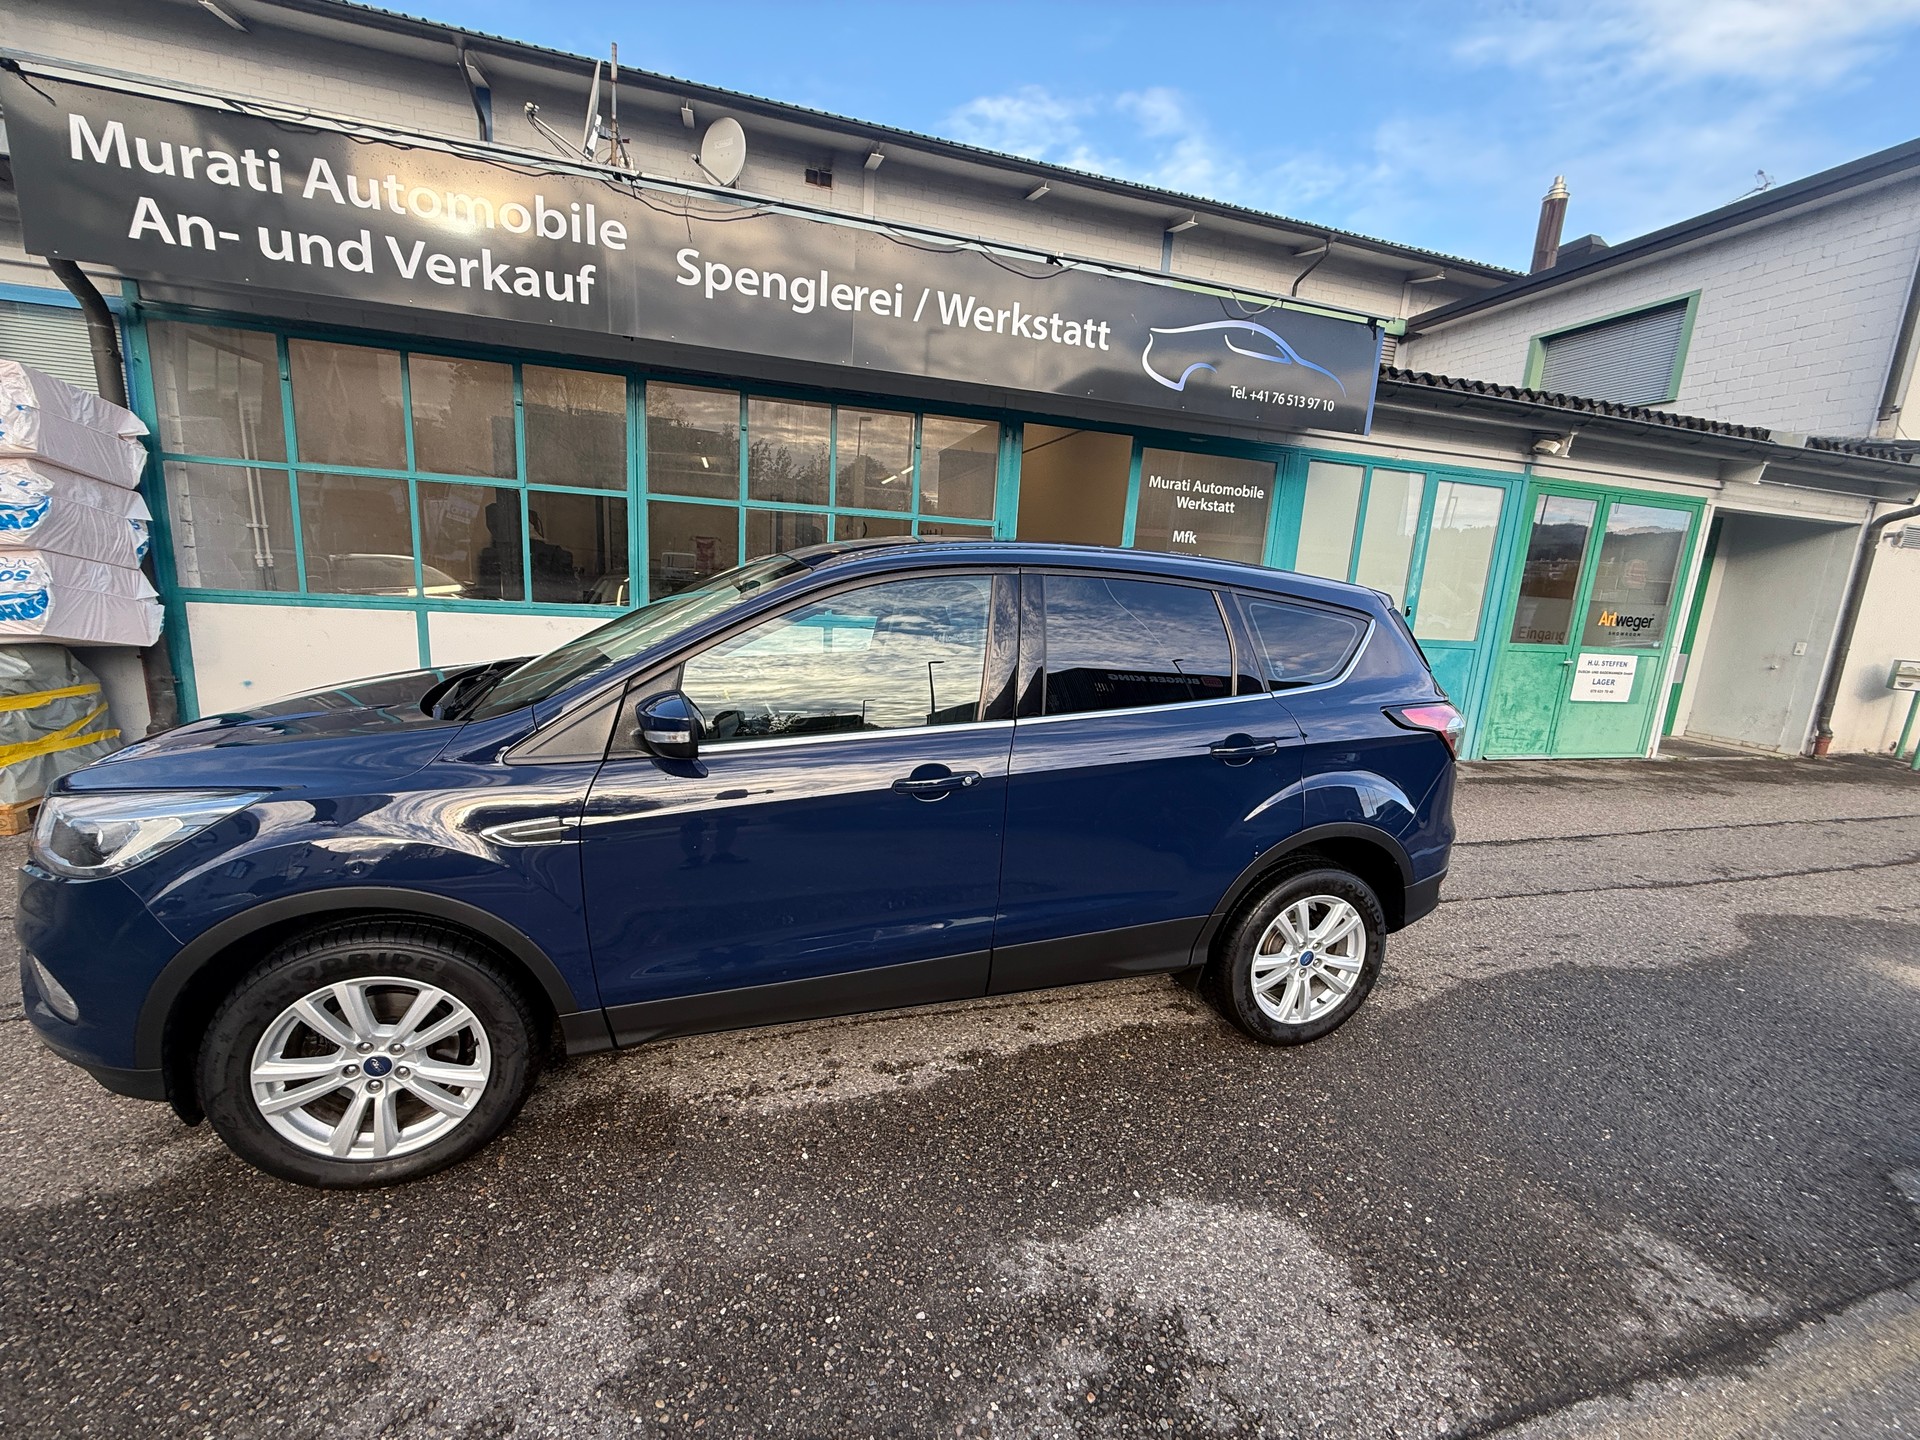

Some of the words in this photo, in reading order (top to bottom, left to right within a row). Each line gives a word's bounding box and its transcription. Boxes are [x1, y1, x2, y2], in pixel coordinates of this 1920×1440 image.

[68, 113, 282, 194] Murati
[303, 157, 628, 251] Automobile
[128, 197, 239, 251] An-
[258, 227, 374, 274] und
[385, 235, 596, 305] Verkauf
[676, 248, 903, 318] Spenglerei
[913, 288, 930, 322] /
[936, 290, 1111, 351] Werkstatt
[1230, 385, 1248, 399] Tel.
[1249, 390, 1269, 403] +41
[1272, 392, 1285, 405] 76
[1286, 394, 1305, 408] 513
[1307, 397, 1320, 410] 97
[1322, 400, 1335, 412] 10
[1148, 475, 1191, 492] Murati
[1192, 480, 1265, 499] Automobile
[1176, 495, 1235, 513] Werkstatt
[1172, 530, 1197, 544] Mfk
[1598, 611, 1655, 631] Artweger
[1517, 626, 1565, 644] Eingang
[1592, 678, 1616, 686] LAGER
